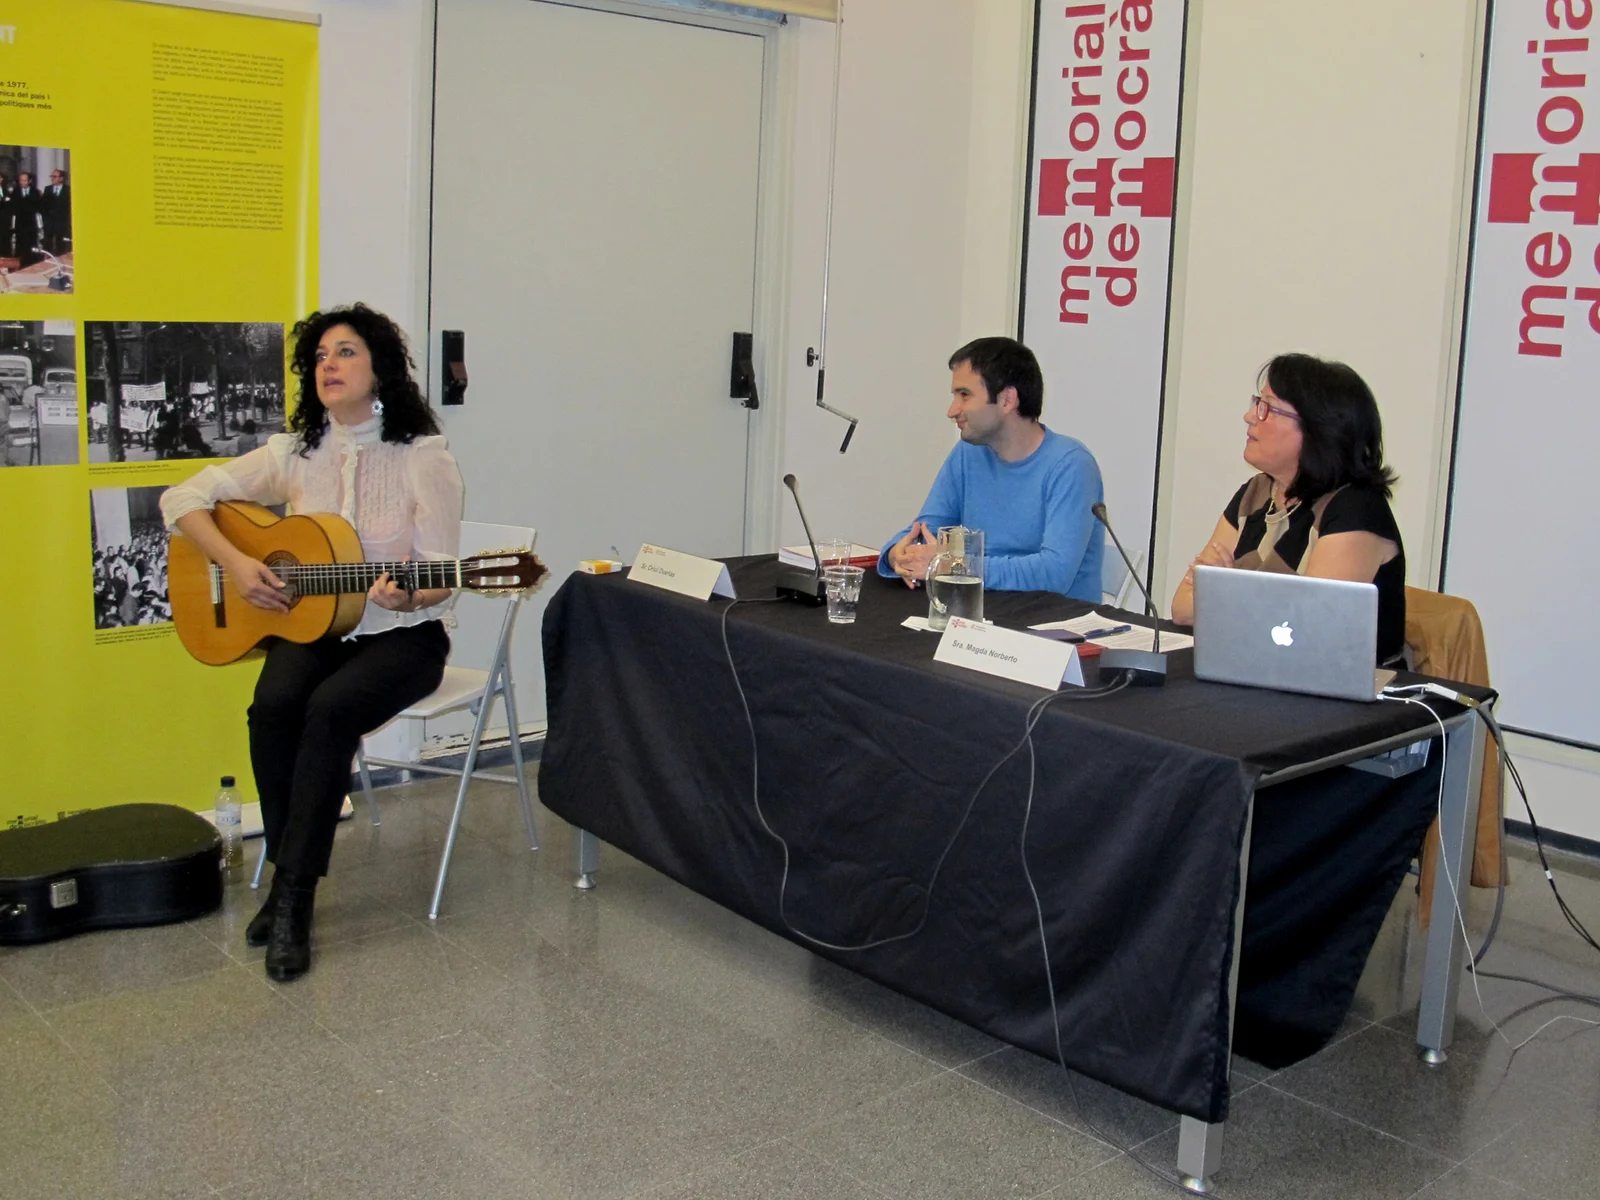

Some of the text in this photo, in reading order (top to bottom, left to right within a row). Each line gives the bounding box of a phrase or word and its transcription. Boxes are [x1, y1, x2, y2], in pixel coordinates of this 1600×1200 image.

[1059, 0, 1106, 324] memorial
[952, 639, 1018, 663] Sra. Magda Norberto
